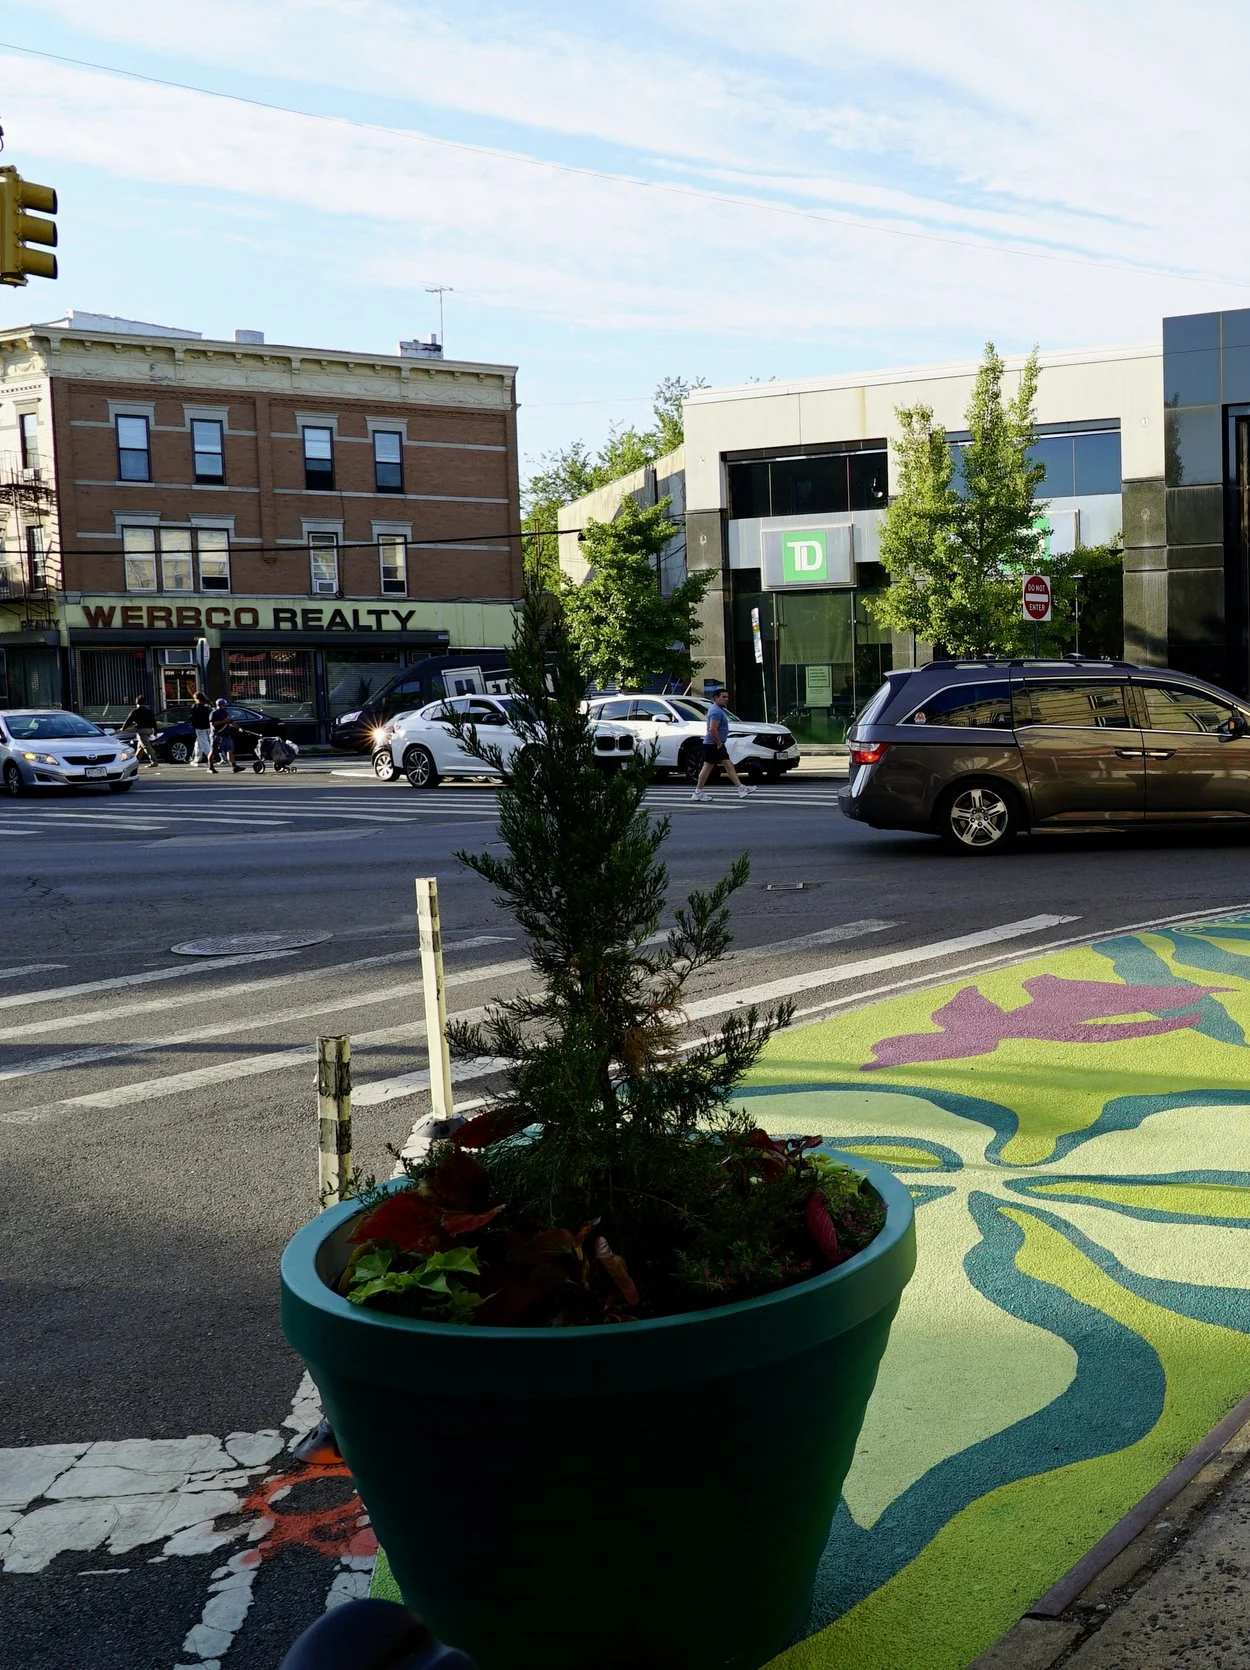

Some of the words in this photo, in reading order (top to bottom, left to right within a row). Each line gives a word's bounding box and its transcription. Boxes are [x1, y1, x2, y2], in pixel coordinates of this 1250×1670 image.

[786, 540, 823, 572] TD
[1036, 584, 1046, 592] NOT
[1029, 603, 1046, 611] ENTER
[81, 605, 259, 630] WERBCO
[273, 607, 416, 631] REALTY
